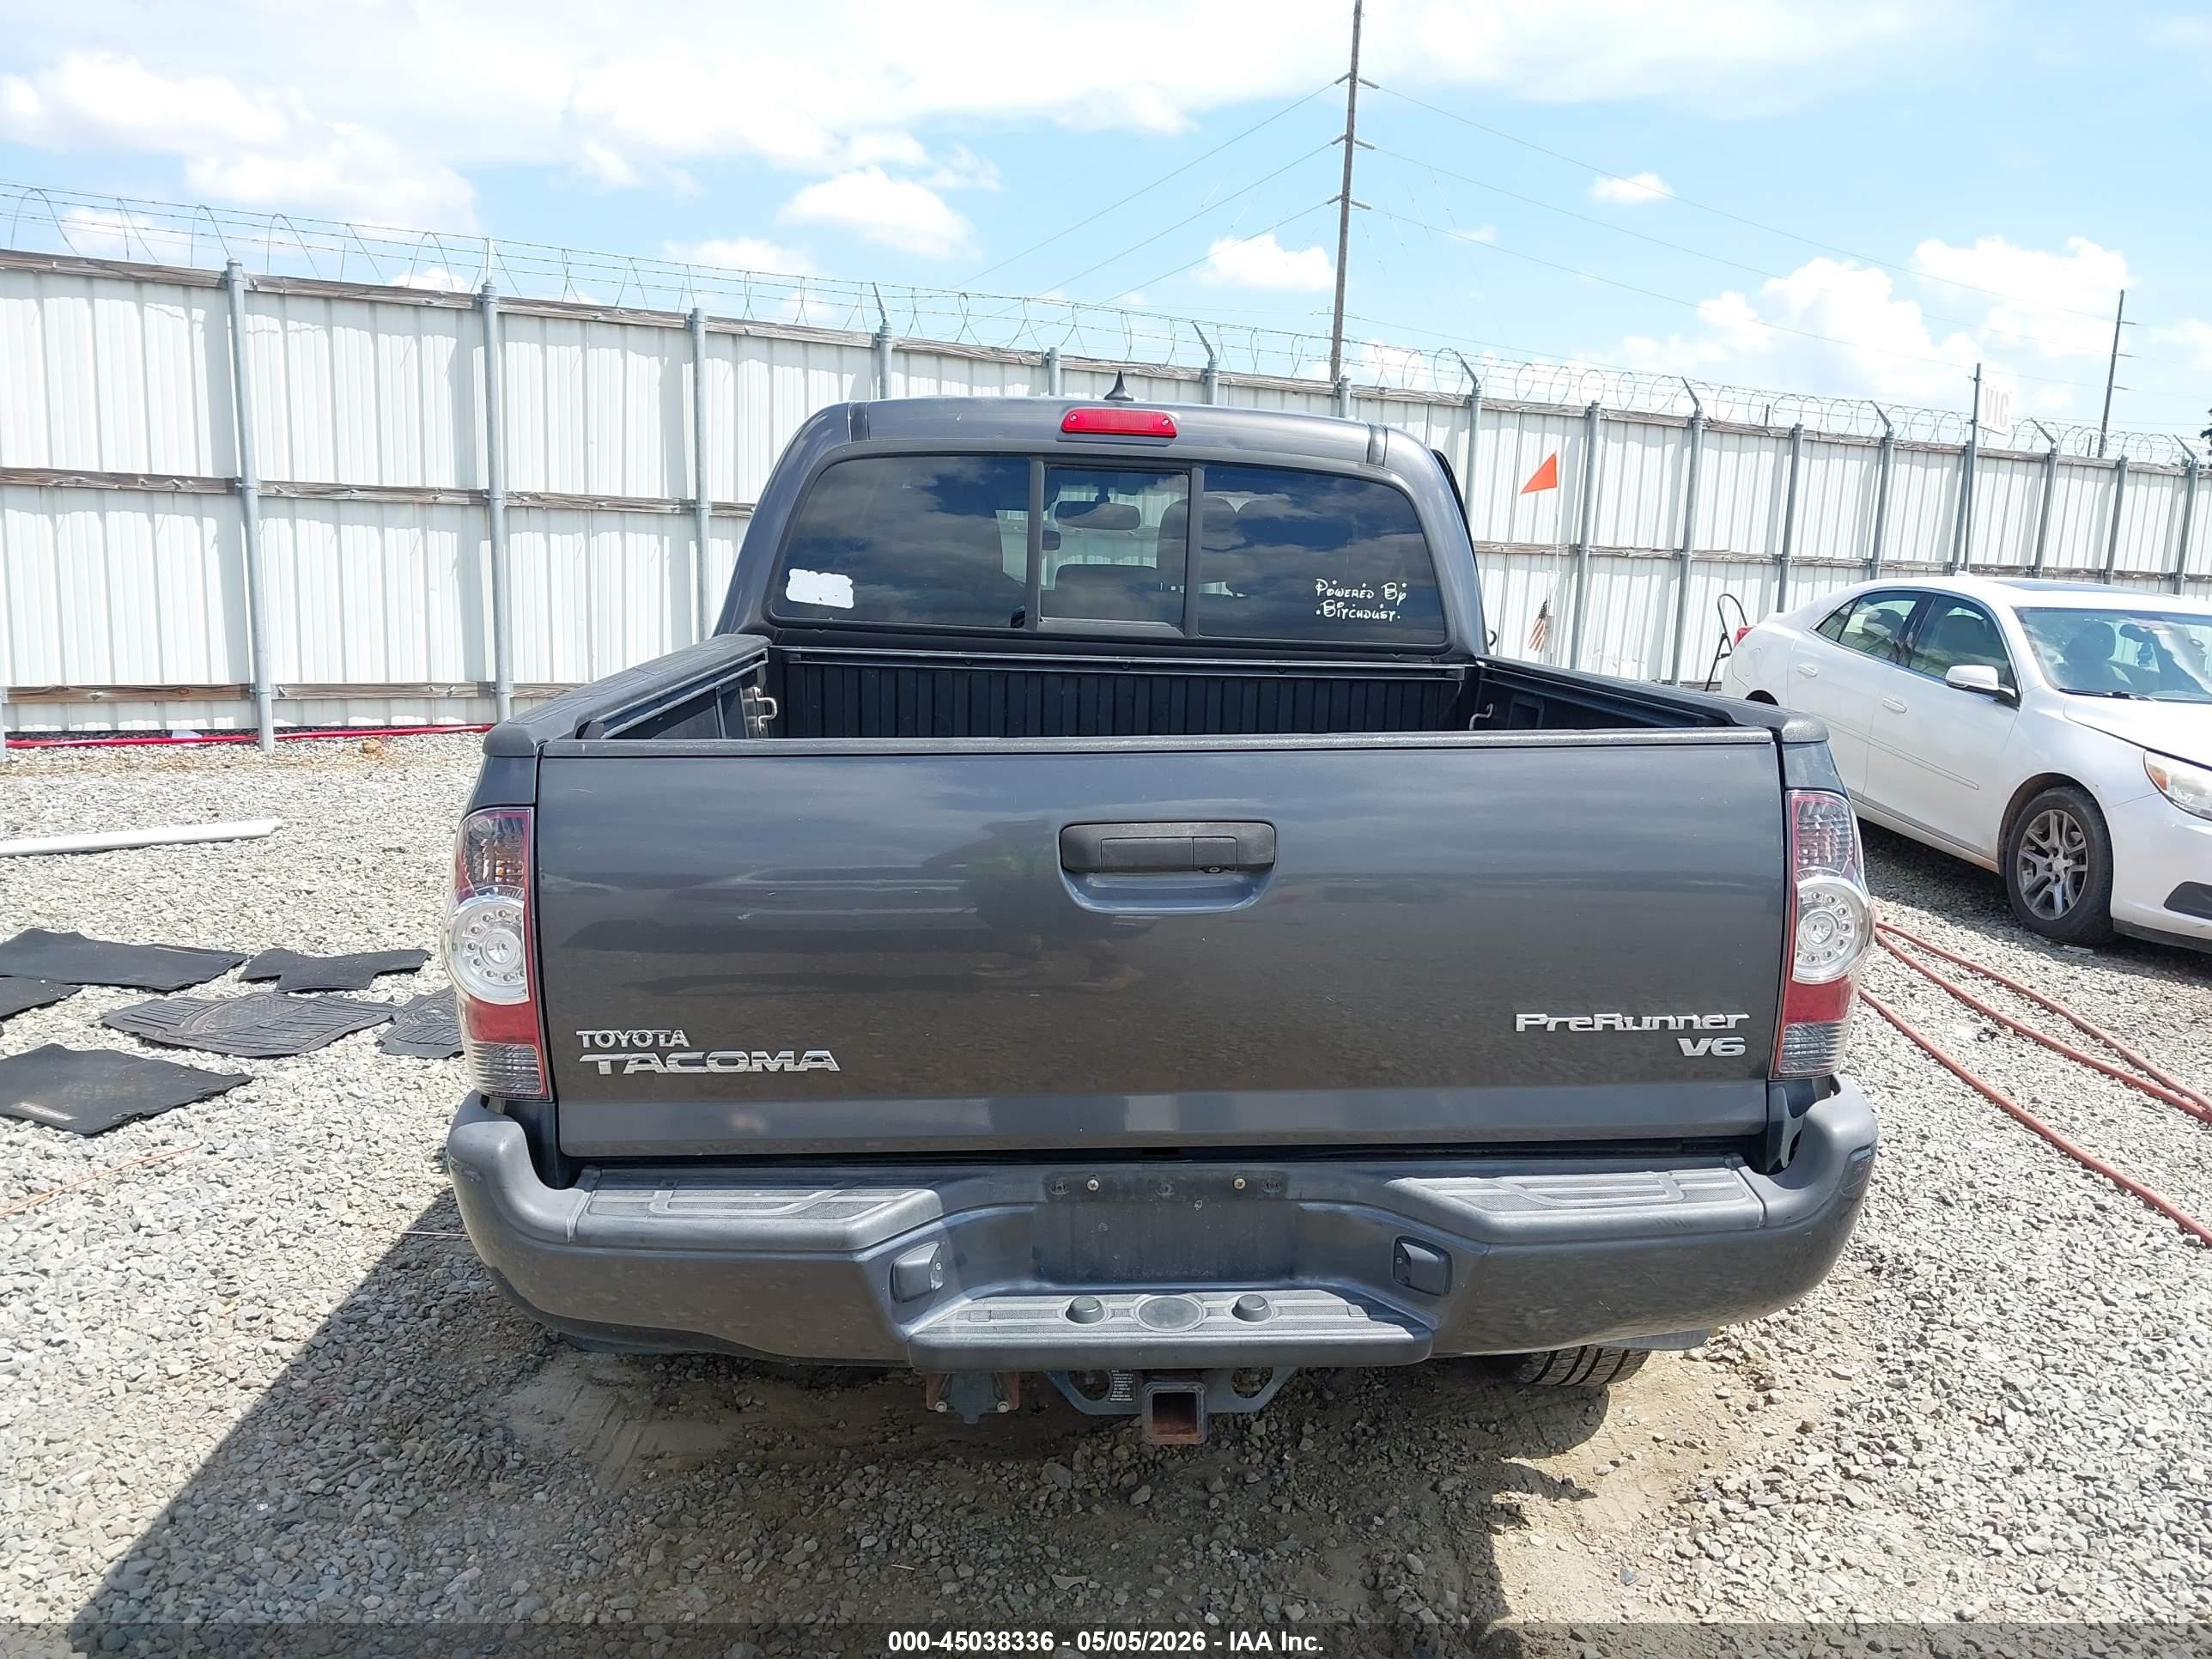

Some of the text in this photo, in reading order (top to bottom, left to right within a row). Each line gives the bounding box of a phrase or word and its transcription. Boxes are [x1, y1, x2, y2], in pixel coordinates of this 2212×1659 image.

[1516, 1013, 1750, 1031] PreRunner
[576, 1030, 690, 1048] TOYOTA
[1677, 1037, 1746, 1056] V6
[579, 1050, 841, 1075] TACOMA
